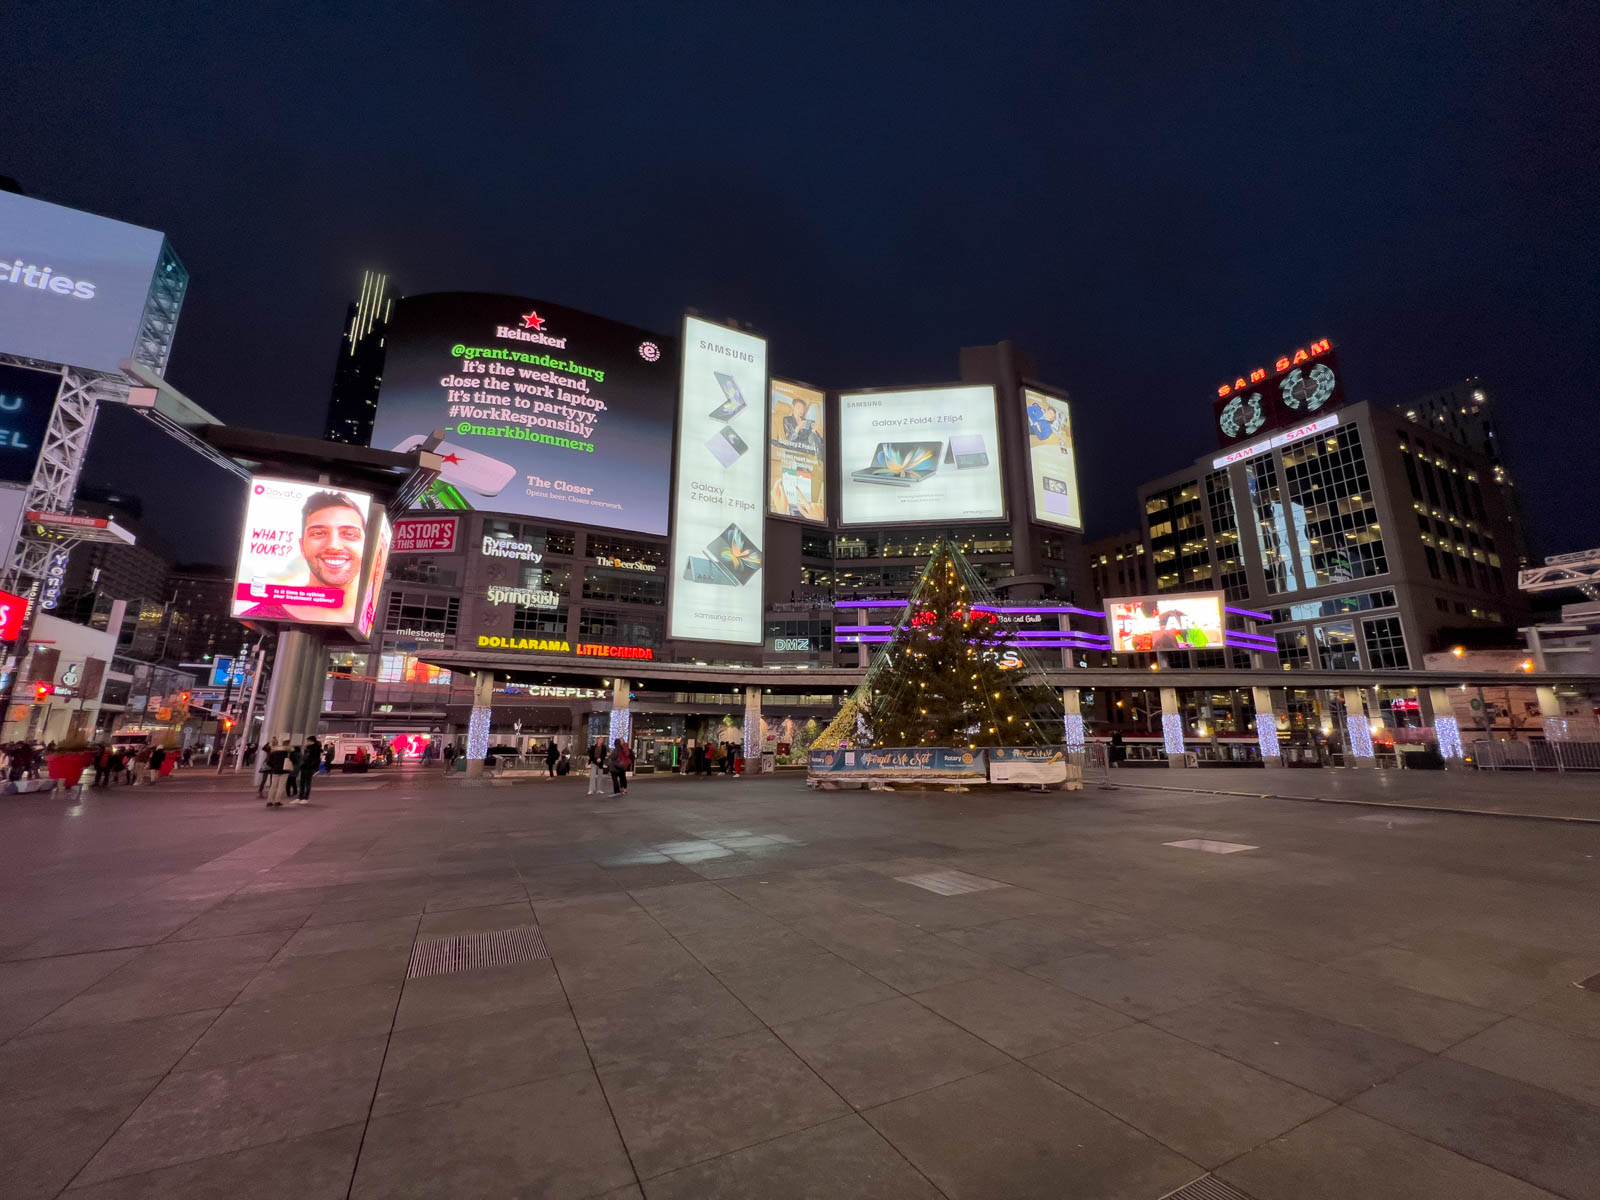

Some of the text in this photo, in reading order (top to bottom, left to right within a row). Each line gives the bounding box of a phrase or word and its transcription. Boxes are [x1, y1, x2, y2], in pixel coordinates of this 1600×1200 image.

[496, 326, 566, 349] Heineken
[699, 340, 755, 363] SAMSUNG
[451, 344, 605, 382] @grant.vander.burg
[1218, 339, 1330, 397] SAM SAM
[462, 360, 590, 393] It's the weekend,
[440, 375, 608, 411] close the work laptop.
[447, 390, 598, 424] It's time to partyyy.
[846, 400, 883, 409] SAMSUNG
[449, 405, 594, 439] #WorkResponsibly
[872, 418, 903, 428] Galaxy
[909, 417, 933, 425] Fold4
[943, 414, 964, 423] Flip4
[456, 421, 595, 453] @markblommers
[1285, 423, 1318, 440] SAM
[1226, 447, 1254, 463] SAM
[266, 487, 303, 499] Dovato
[527, 475, 594, 496] The Closer
[691, 481, 725, 497] Galaxy
[691, 491, 756, 512] Z Fold4 Z Flip4
[252, 528, 294, 543] WHAT'S
[397, 523, 453, 539] ASTOR'S
[250, 542, 293, 558] YOURS?
[397, 540, 415, 549] THIS
[416, 539, 435, 549] WAY
[482, 536, 533, 552] Ryerson
[482, 546, 543, 564] University
[596, 556, 614, 567] The
[23, 581, 40, 621] DOWNTOWN
[694, 612, 743, 623] samsung.com
[997, 615, 1011, 623] Bar
[1025, 614, 1041, 623] Grill
[396, 628, 445, 639] milestones
[478, 635, 570, 652] DOLLARAMA
[774, 639, 809, 651] DMZ
[609, 646, 653, 660] CANADA
[528, 686, 606, 699] CINEPLEX
